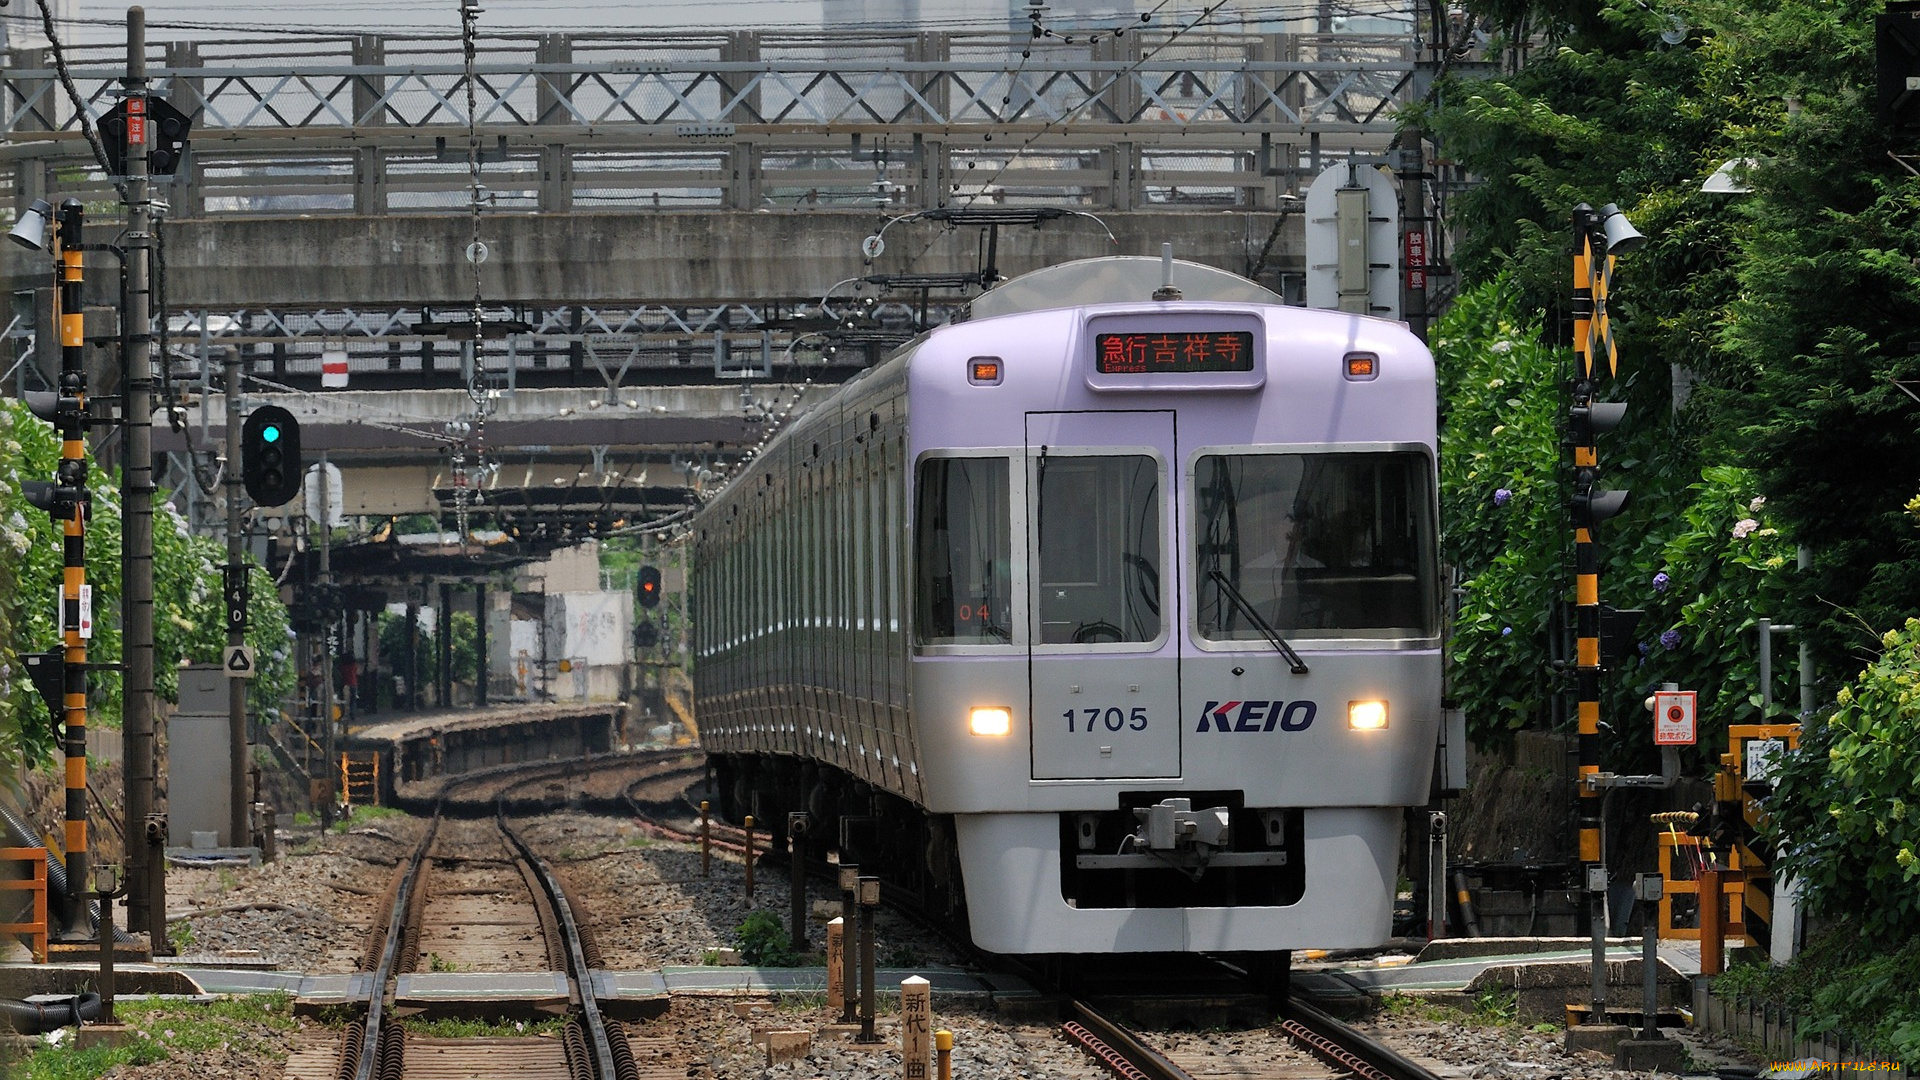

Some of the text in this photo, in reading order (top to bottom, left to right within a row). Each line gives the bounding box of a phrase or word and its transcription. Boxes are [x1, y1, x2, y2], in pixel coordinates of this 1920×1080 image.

[1410, 232, 1423, 288] 触車注意
[1103, 333, 1243, 363] 急行 吉祥寺
[1105, 363, 1147, 372] Express
[959, 604, 989, 620] 04
[1062, 707, 1148, 732] 1705
[1196, 700, 1318, 733] KEIO
